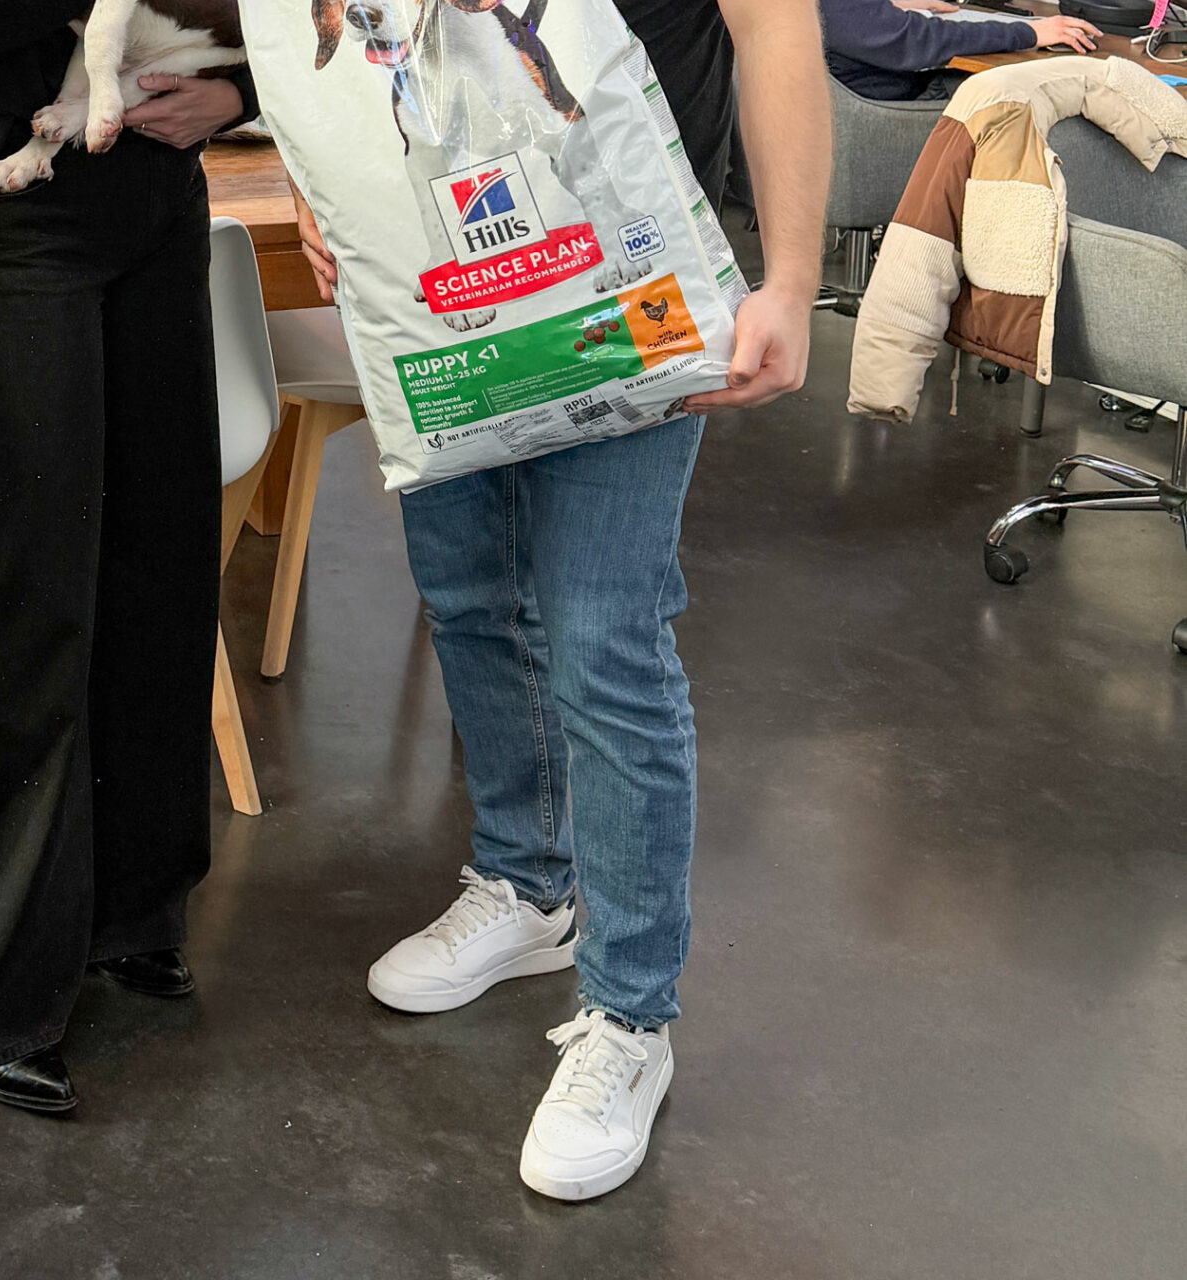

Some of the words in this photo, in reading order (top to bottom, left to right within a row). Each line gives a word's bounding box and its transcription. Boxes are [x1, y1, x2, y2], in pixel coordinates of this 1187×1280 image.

[462, 216, 531, 254] Hill's
[624, 220, 650, 234] HEALTHY
[624, 229, 660, 252] 100%
[434, 257, 527, 296] SCIENCE
[529, 235, 589, 269] PLAN
[440, 280, 513, 307] VETERINARIAN
[514, 255, 591, 286] RECOMMENDED
[646, 329, 687, 351] CHICKEN
[657, 329, 673, 340] with
[403, 350, 469, 379] PUPPY
[478, 343, 500, 360] <1
[407, 375, 444, 388] MEDIUM
[472, 365, 487, 376] KG
[624, 383, 634, 391] NO
[635, 369, 672, 388] ARTIFICIAL
[410, 387, 430, 396] ADULT
[431, 382, 456, 392] WEIGHT
[417, 407, 444, 417] nutrition
[452, 399, 478, 411] support
[432, 394, 461, 406] balanced
[563, 394, 594, 413] RP07
[420, 414, 444, 425] optimal
[444, 409, 467, 421] growth
[446, 433, 460, 442] NOT
[461, 422, 503, 438] ARTIFICIALLY
